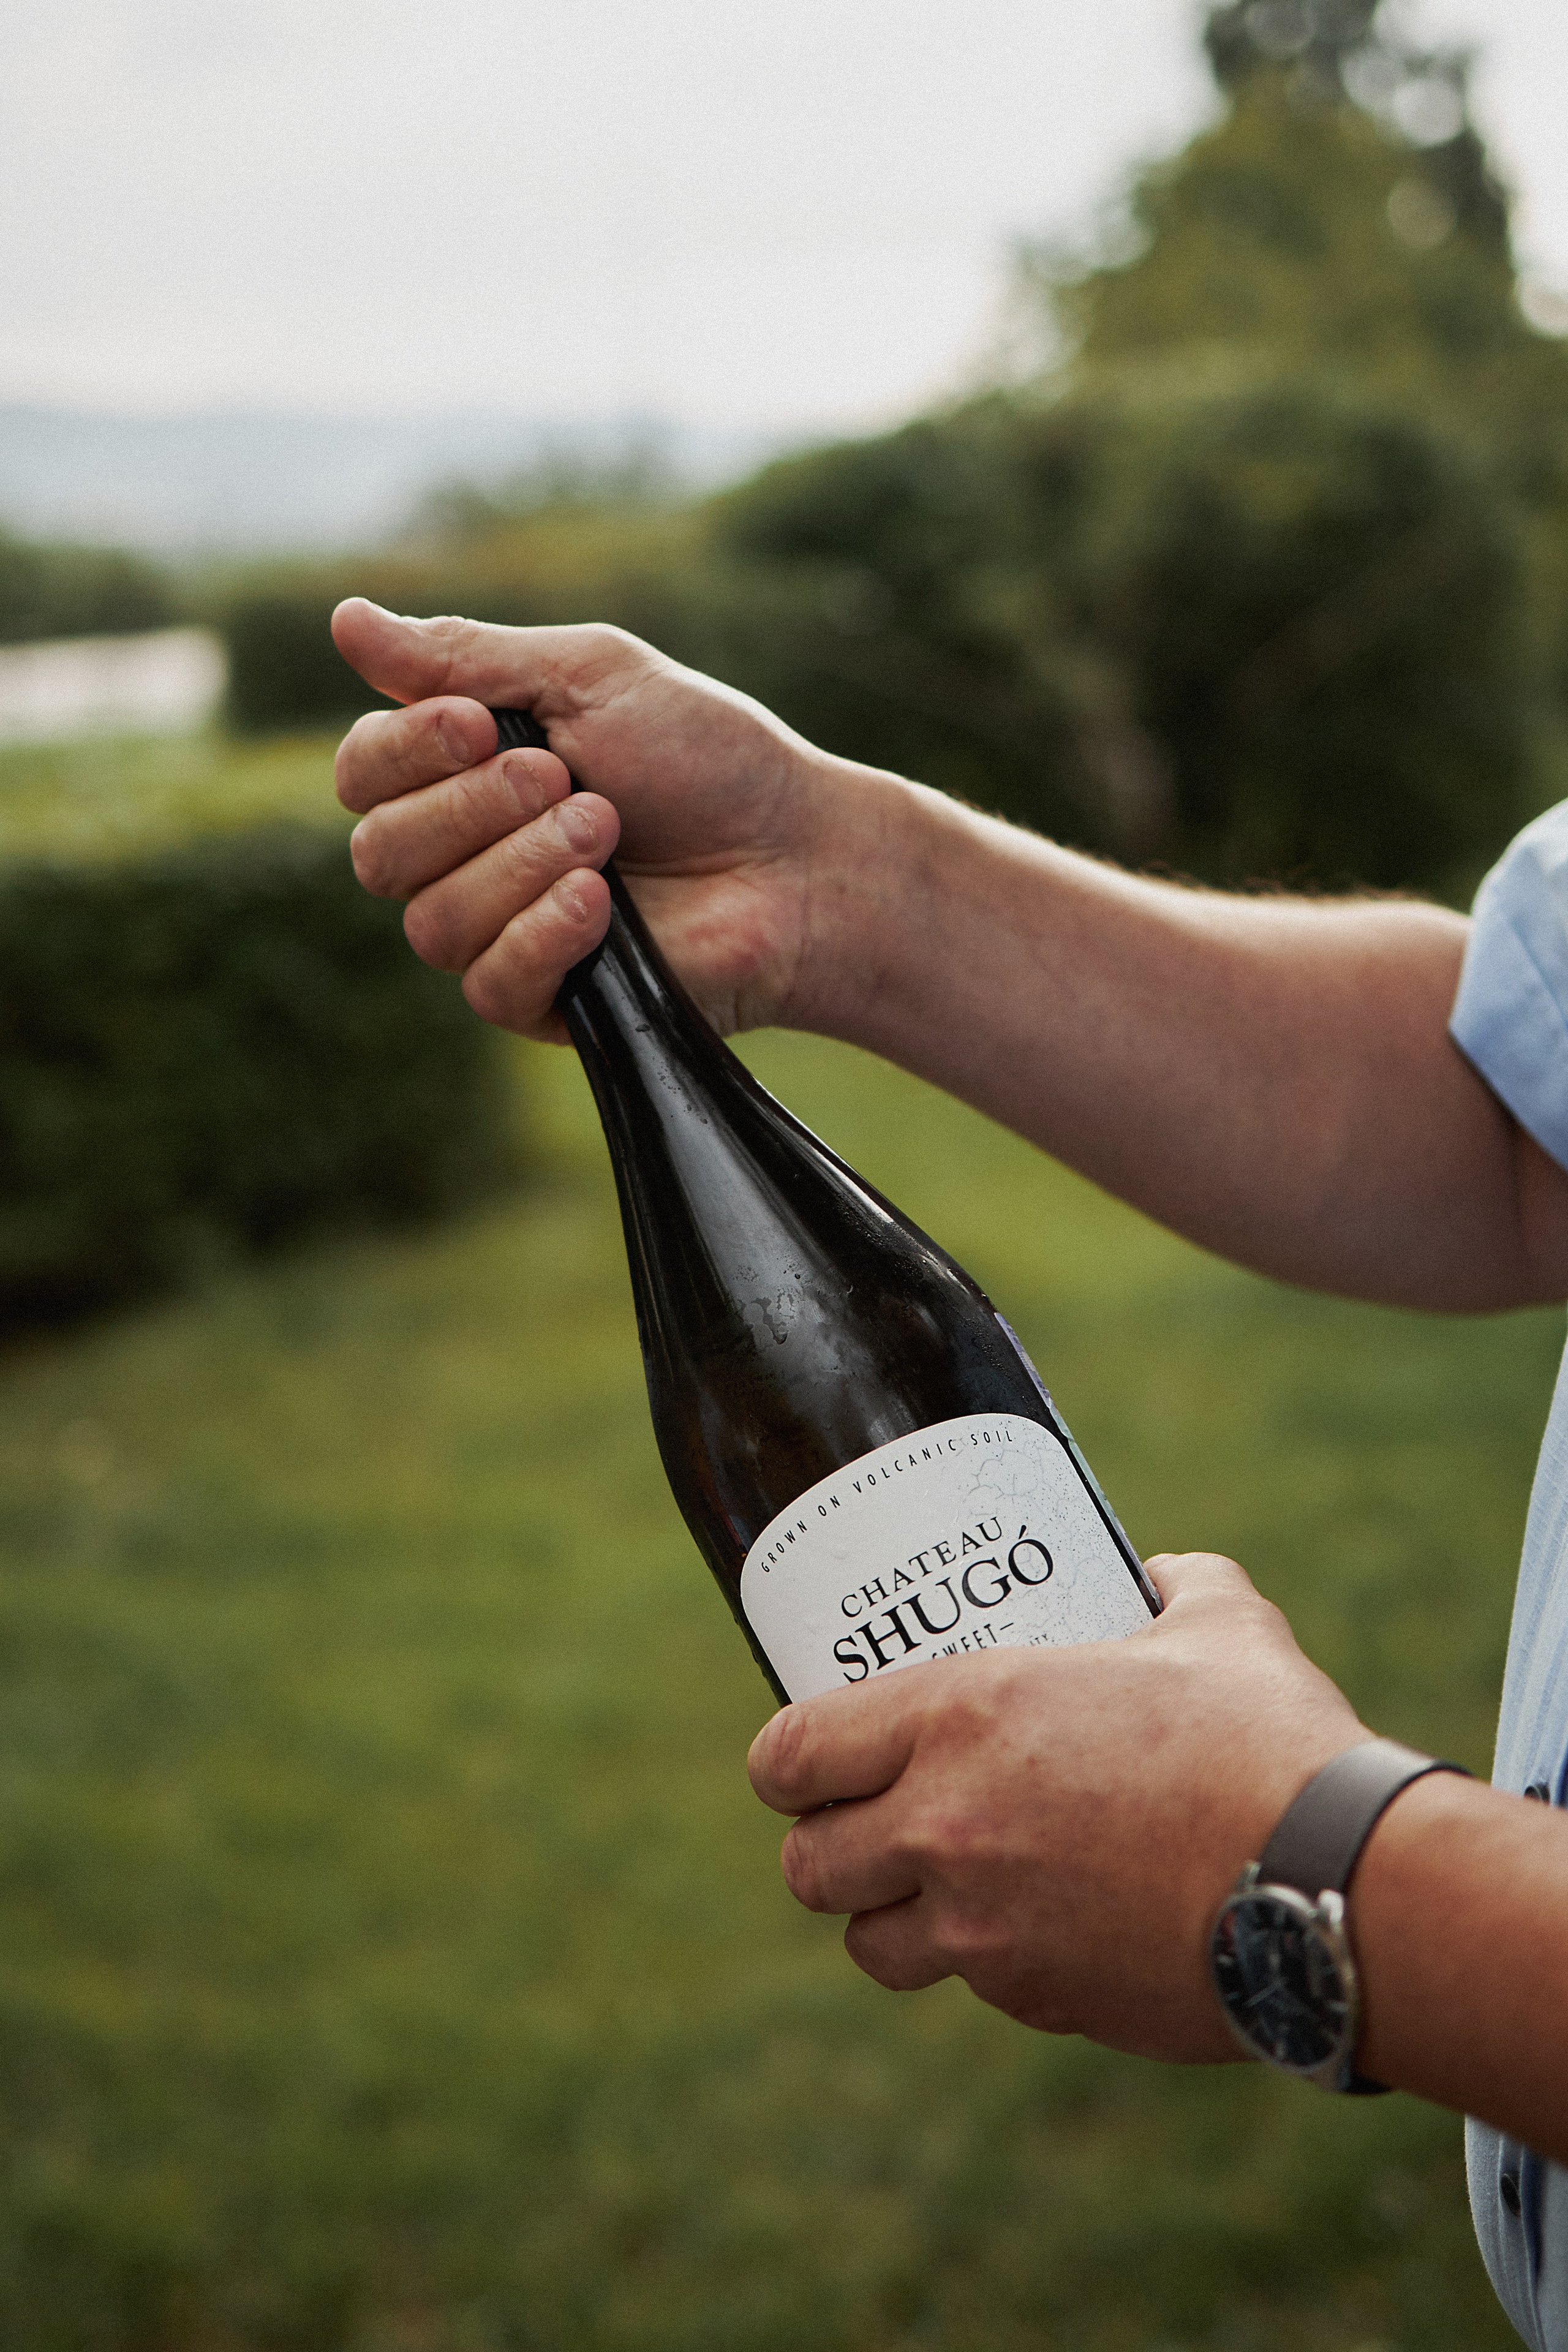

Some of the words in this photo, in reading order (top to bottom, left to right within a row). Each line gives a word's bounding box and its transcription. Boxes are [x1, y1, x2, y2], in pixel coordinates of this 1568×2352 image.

[761, 1520, 807, 1573] GROWN
[818, 1496, 841, 1517] ON
[853, 1439, 956, 1493] VOLCANIC
[970, 1430, 1013, 1446] SOIL
[841, 1517, 1002, 1618] CHATEAU
[833, 1525, 1054, 1684] SHUGÓ
